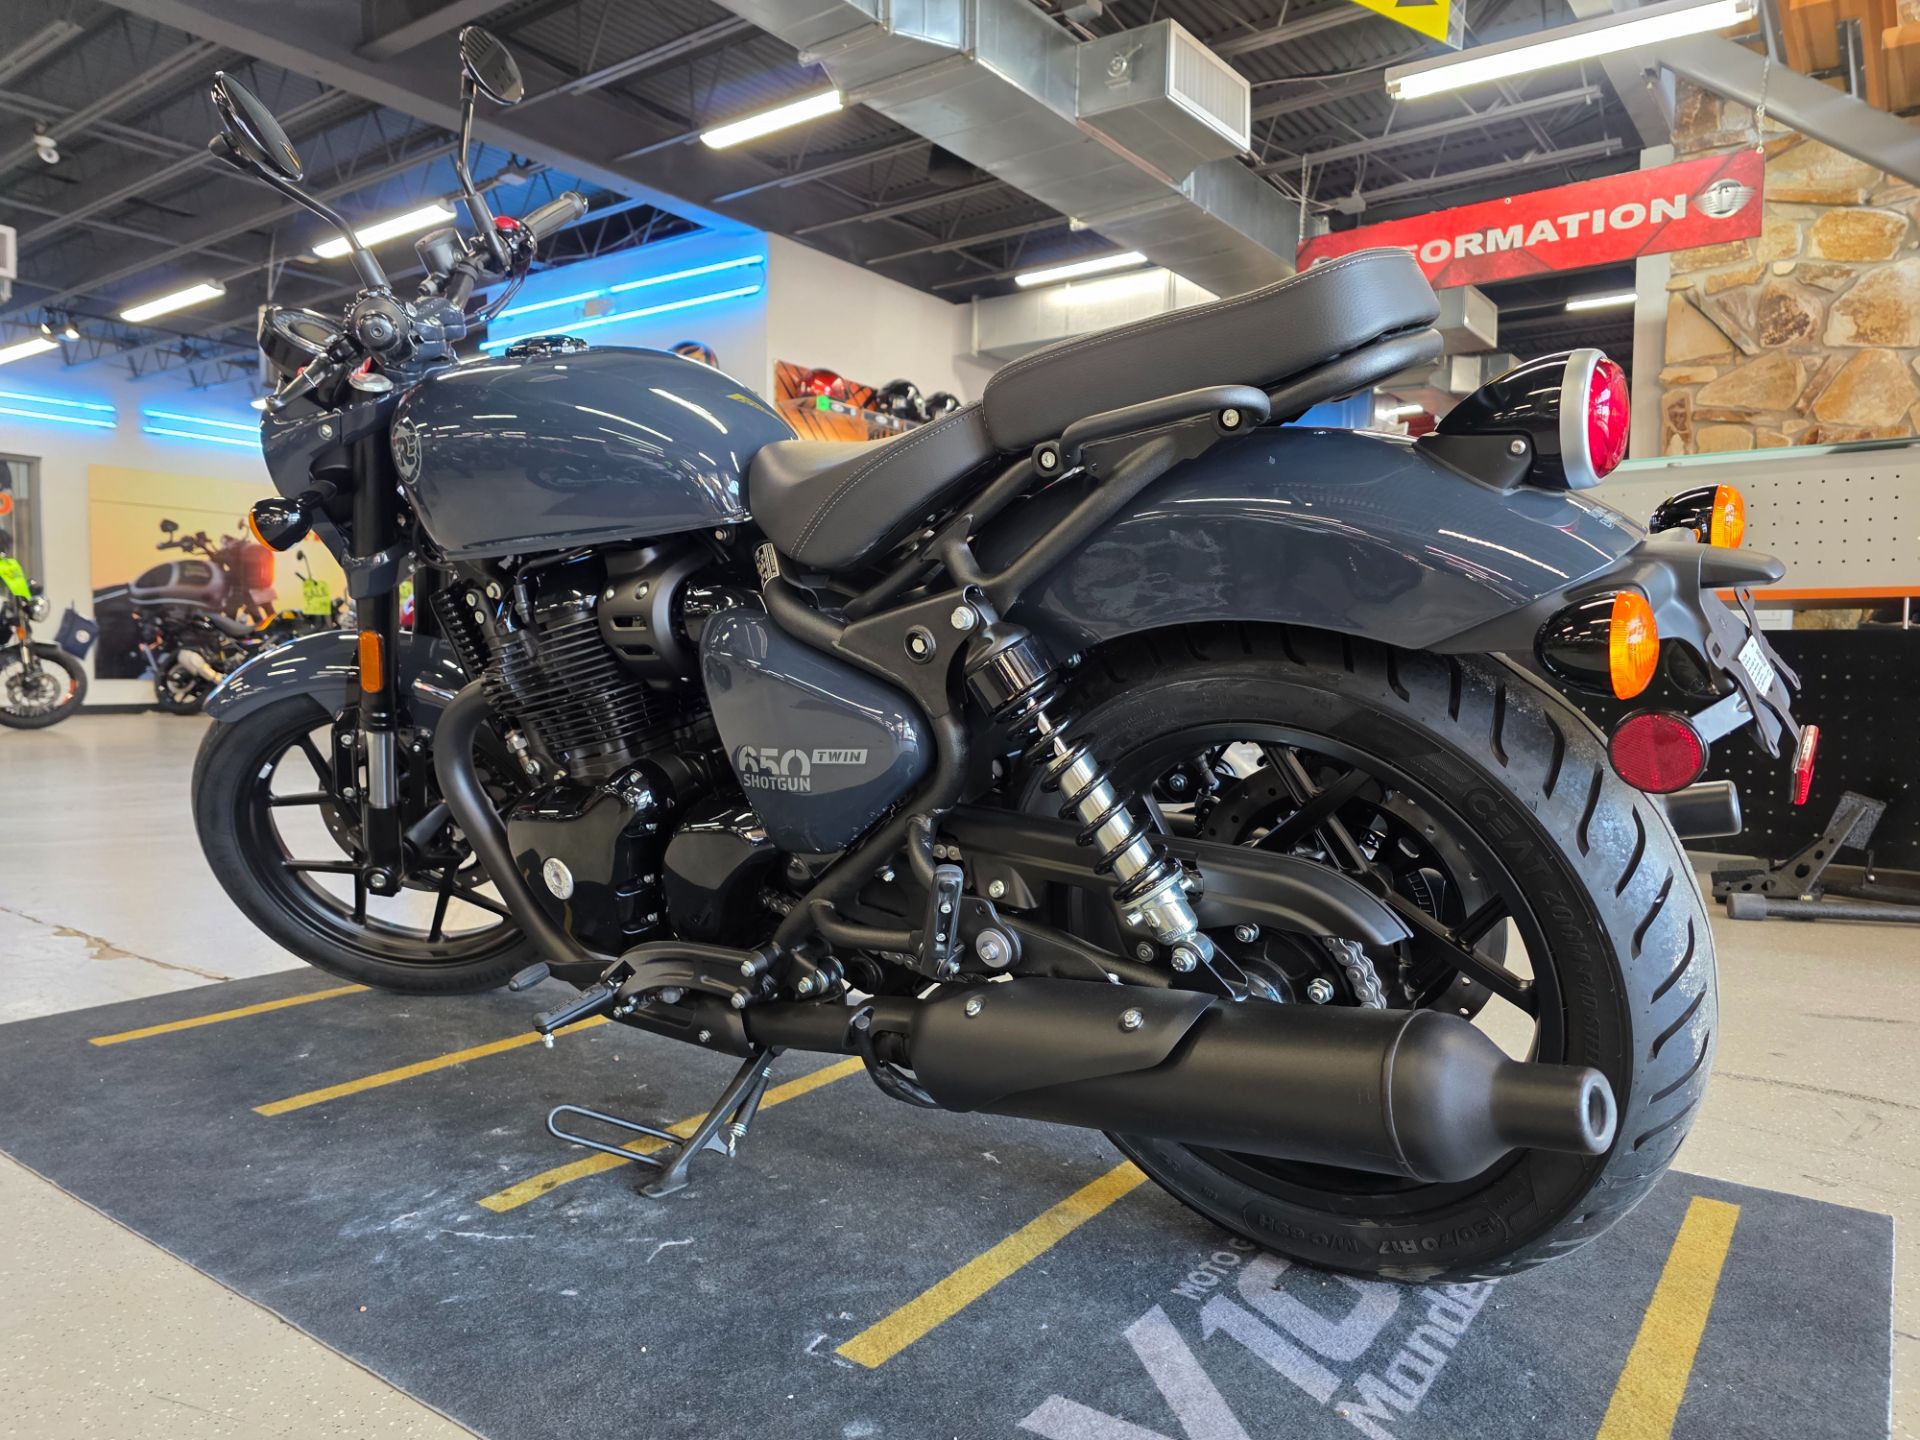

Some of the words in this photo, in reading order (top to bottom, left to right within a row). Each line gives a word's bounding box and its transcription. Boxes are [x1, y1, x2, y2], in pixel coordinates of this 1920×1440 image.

[1406, 193, 1687, 266] ORMATION
[738, 745, 811, 775] 650
[815, 750, 864, 763] TWIN
[743, 773, 811, 792] SHOTGUN
[1168, 1251, 1242, 1302] MOTO
